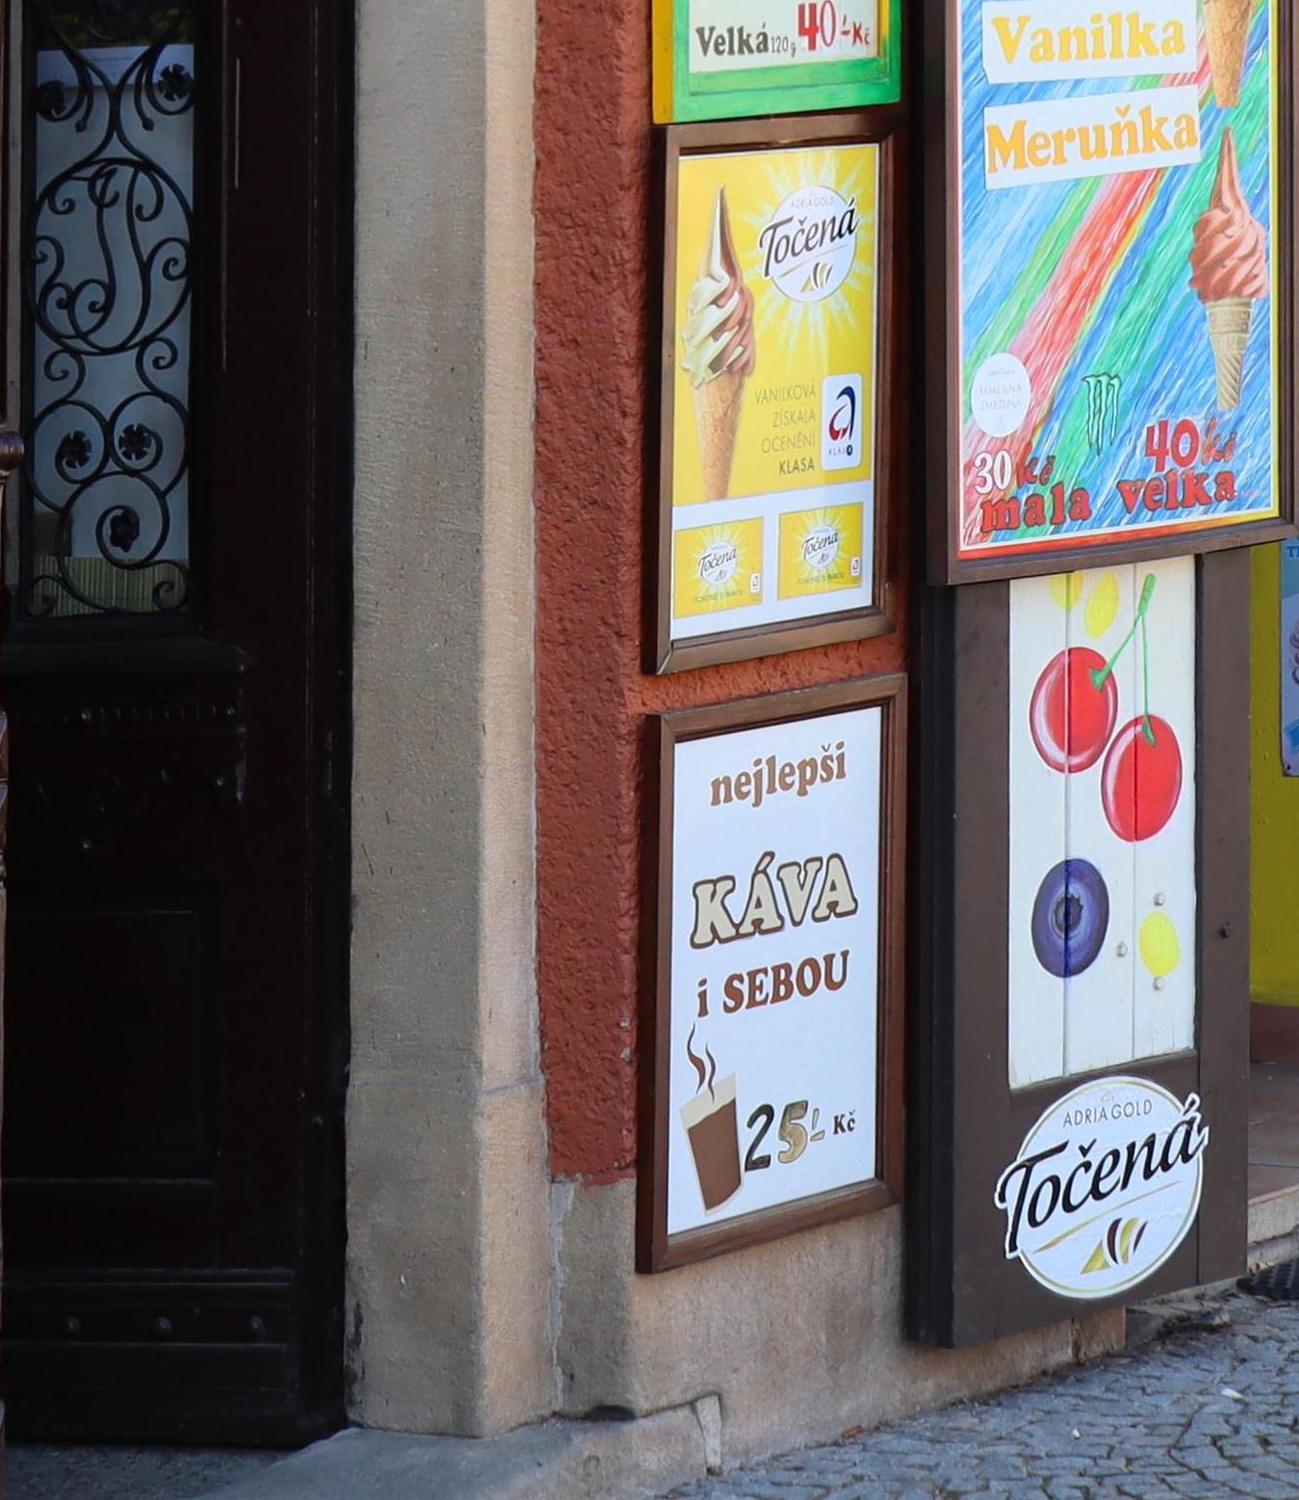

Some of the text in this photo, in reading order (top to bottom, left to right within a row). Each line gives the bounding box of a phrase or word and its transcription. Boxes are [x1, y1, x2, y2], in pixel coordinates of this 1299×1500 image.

[695, 22, 769, 57] Velká
[992, 11, 1186, 64] Vanilka
[986, 103, 1198, 174] Meruňka
[759, 197, 859, 277] Točená
[754, 380, 817, 404] VANILKOVÁ
[772, 407, 817, 428] ZÍSKALA
[761, 429, 816, 454] OCENĚNÍ
[1145, 418, 1200, 472] 40
[779, 457, 815, 476] KLASA
[973, 449, 1013, 494] 30
[690, 850, 859, 950] KÁVA
[722, 949, 851, 1016] SEBOU
[833, 1109, 856, 1136] Kč
[1062, 1099, 1153, 1128] ADRIA GOLD
[998, 1097, 1206, 1254] Točená
